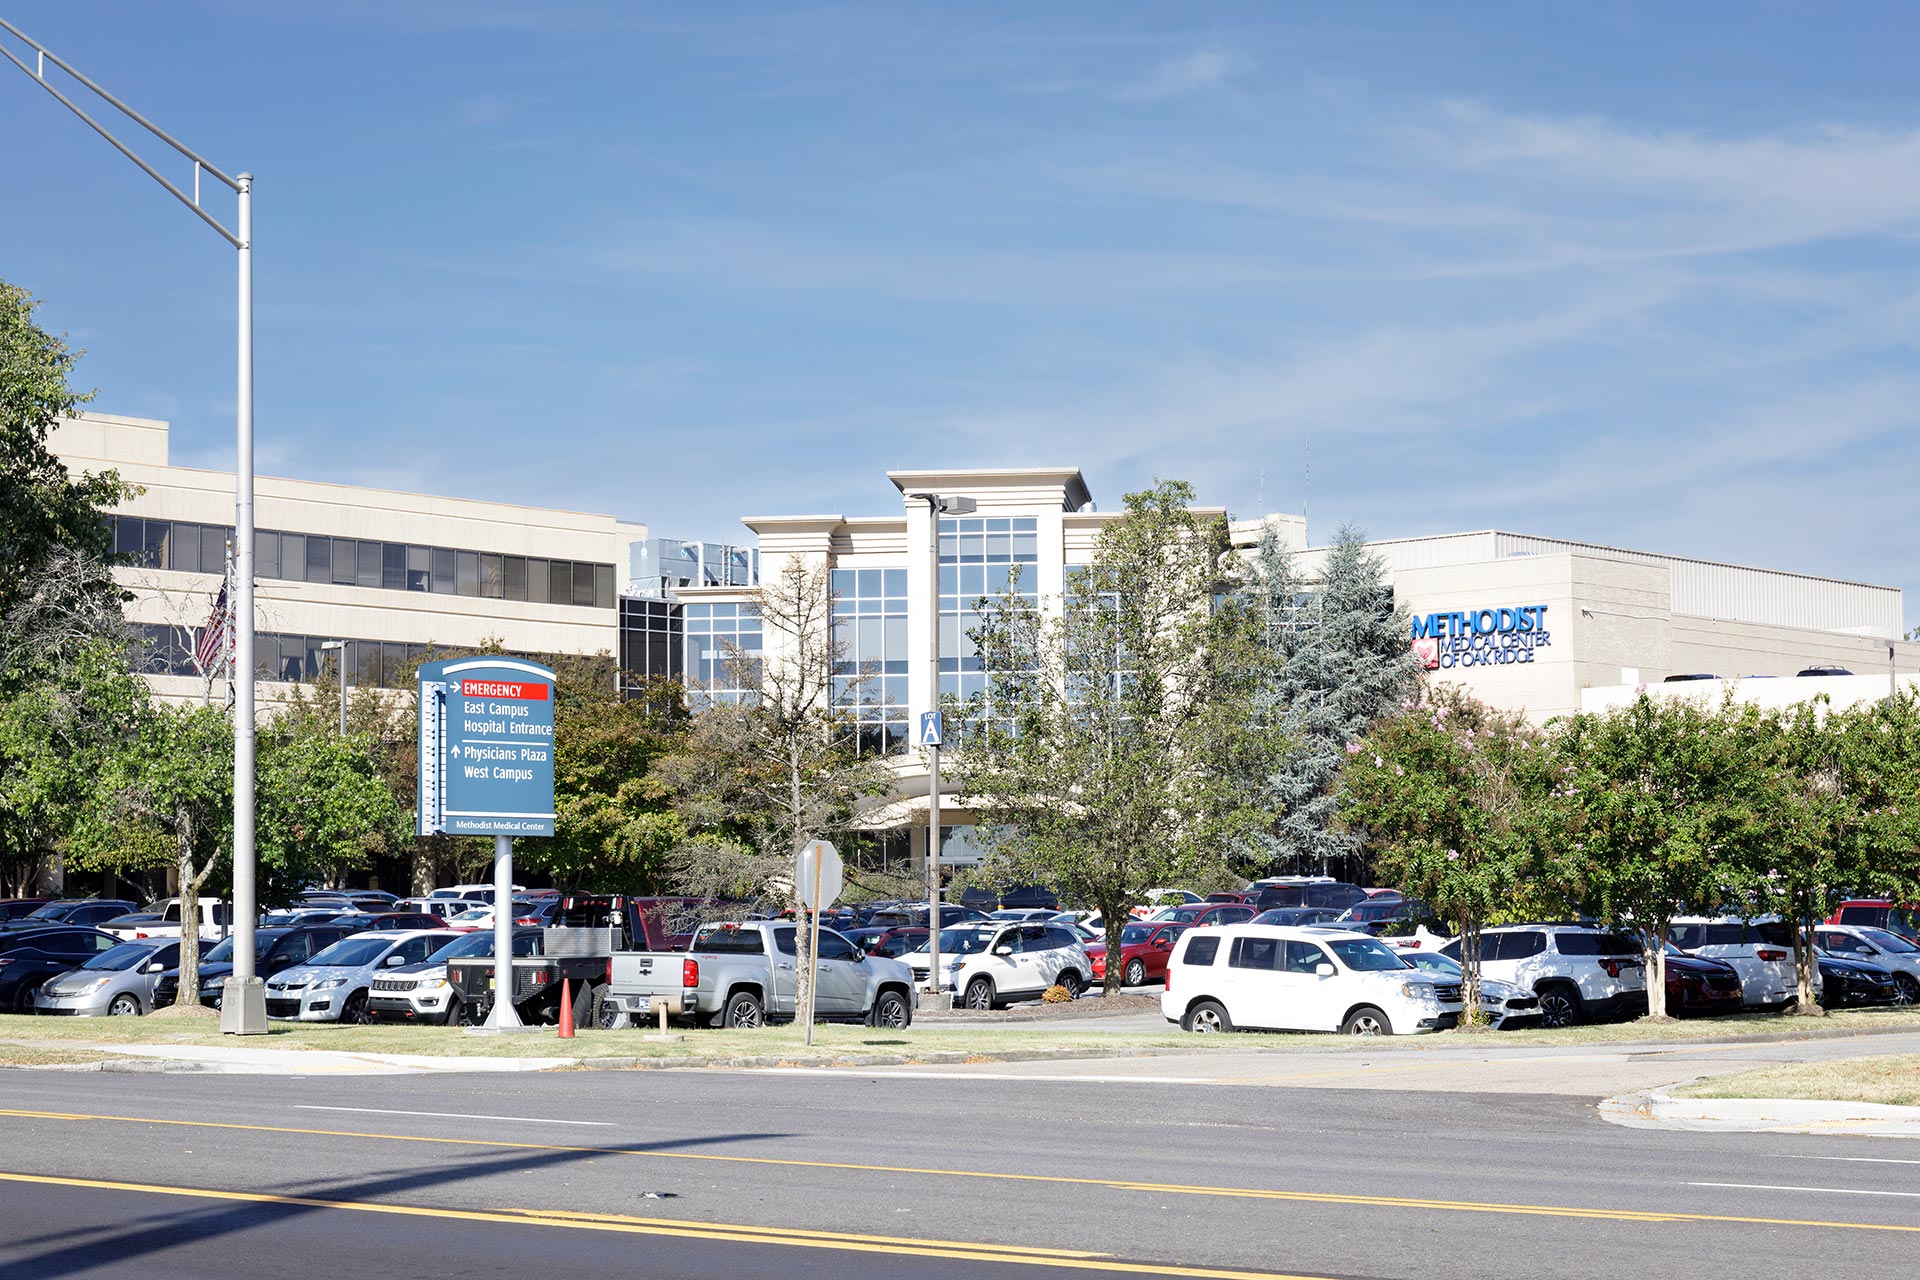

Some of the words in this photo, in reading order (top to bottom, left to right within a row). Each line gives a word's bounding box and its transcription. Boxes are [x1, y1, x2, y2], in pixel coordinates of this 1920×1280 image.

[1411, 605, 1548, 639] METHODIST
[1440, 635, 1499, 653] MEDICAL
[1501, 631, 1551, 649] CENTER
[1440, 652, 1460, 669] OF
[1461, 651, 1492, 667] OAK
[1494, 647, 1535, 665] RIDGE
[464, 682, 522, 697] EMERGENCY
[464, 701, 485, 715] East
[489, 702, 529, 718] Campus
[464, 720, 506, 736] Hospital
[510, 721, 553, 736] Entrance
[922, 719, 940, 743] A
[464, 746, 517, 762] Physicians
[521, 748, 547, 762] Plaza
[464, 765, 489, 779] West
[493, 766, 533, 782] Campus
[456, 820, 492, 830] Methodist
[493, 821, 521, 830] Medical
[522, 822, 545, 831] Center
